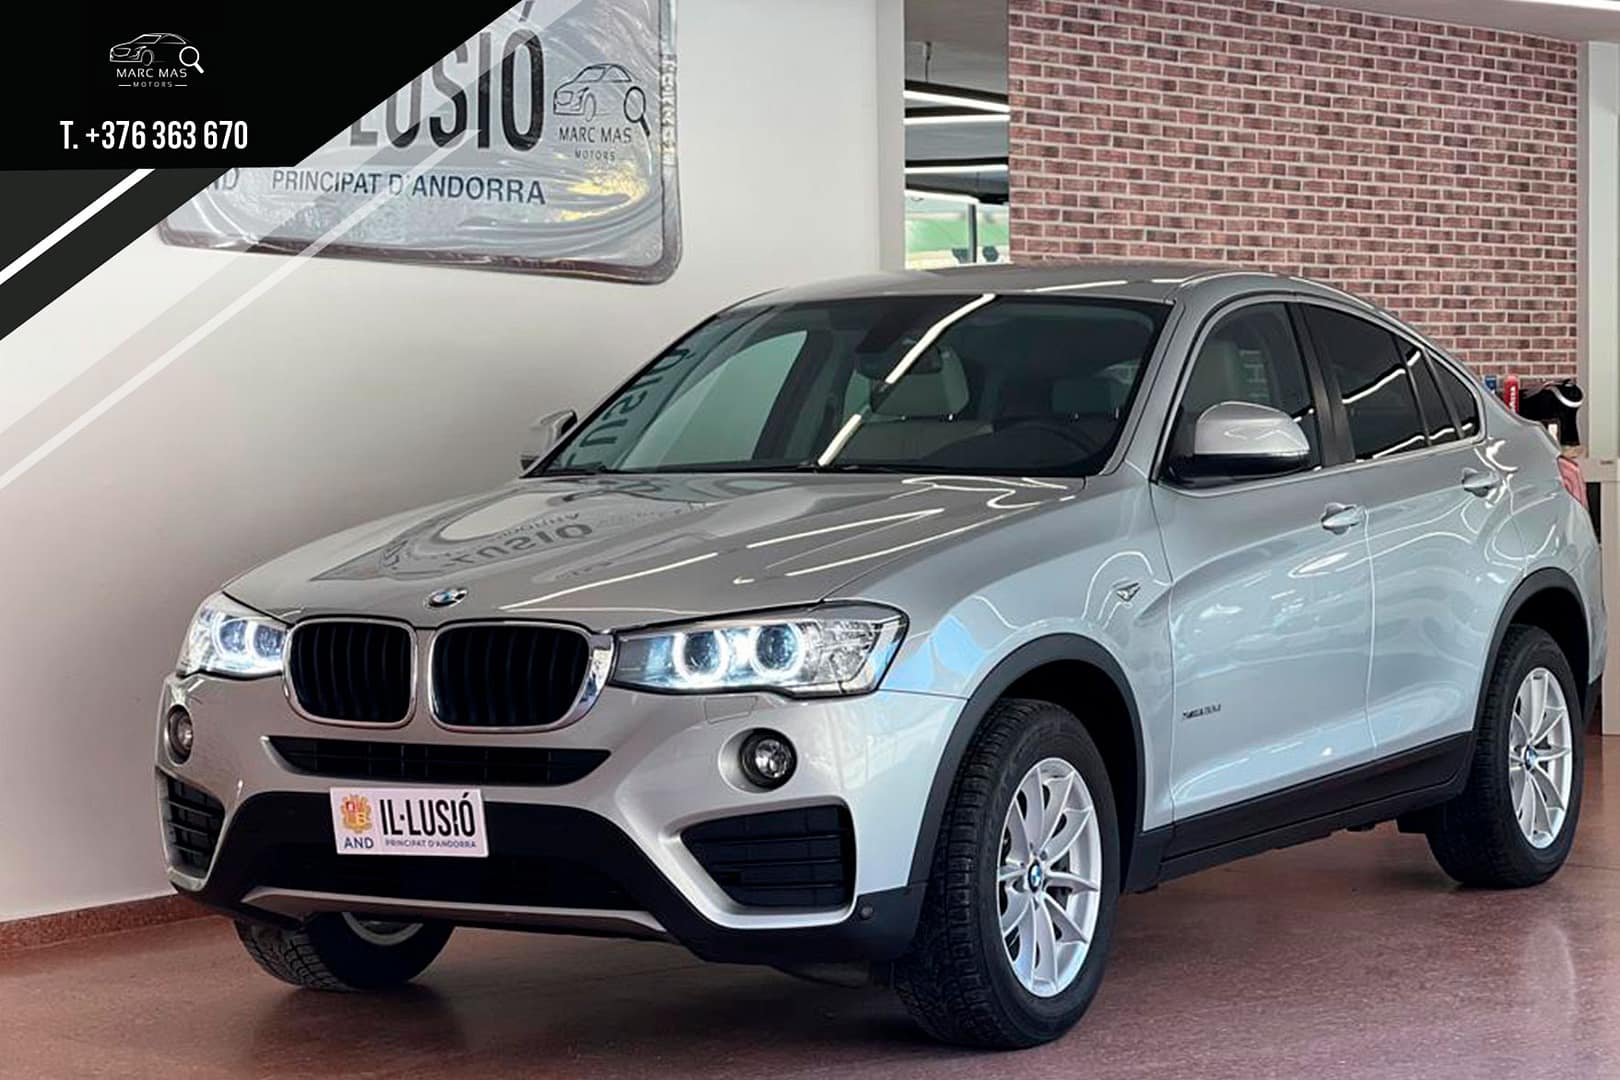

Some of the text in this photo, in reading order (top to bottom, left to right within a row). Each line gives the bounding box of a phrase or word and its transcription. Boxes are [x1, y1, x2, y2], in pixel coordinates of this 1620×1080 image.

[559, 126, 632, 144] MARC MAS
[575, 149, 616, 161] MOTORS
[272, 169, 382, 194] PRINCIPAT
[388, 172, 546, 205] D'ANDORRA
[343, 836, 375, 849] AND
[385, 838, 477, 849] PRINCIPAT D'ANDORRA
